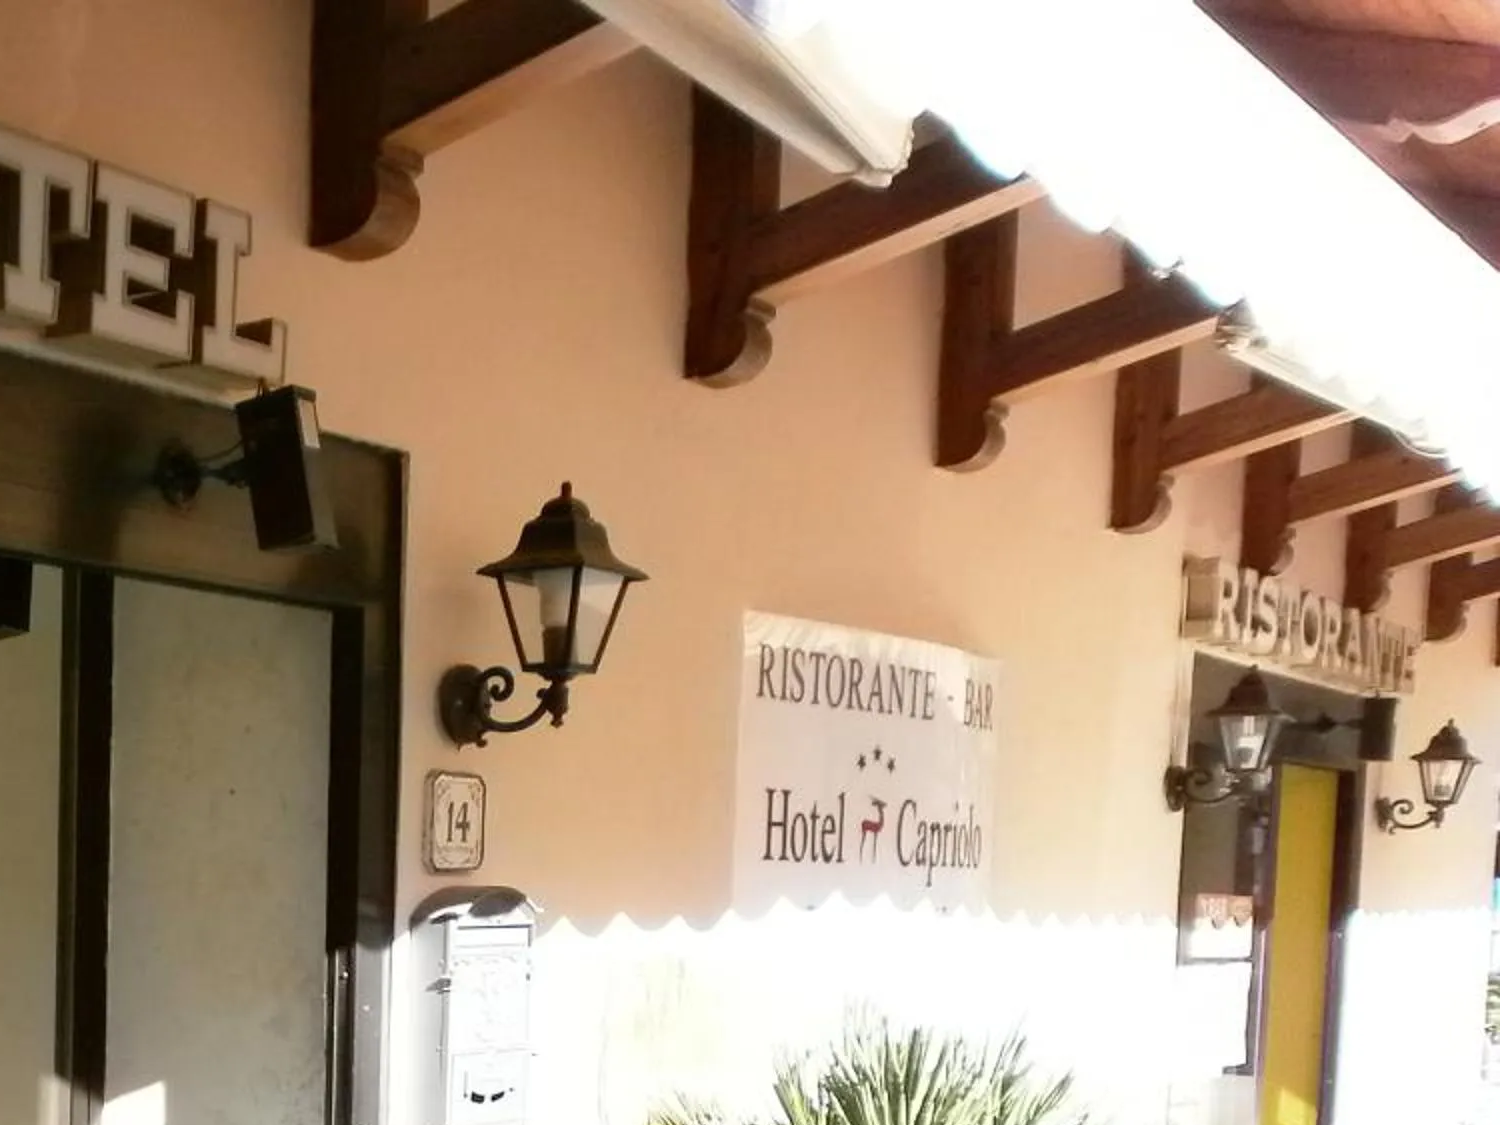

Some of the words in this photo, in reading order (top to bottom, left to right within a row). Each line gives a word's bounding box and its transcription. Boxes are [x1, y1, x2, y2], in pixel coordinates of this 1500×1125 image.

[1213, 562, 1415, 693] RISTORANTE
[756, 642, 936, 721] RISTORANTE
[962, 676, 994, 731] BAR
[446, 801, 471, 843] 14
[762, 787, 846, 864] Hotel
[895, 798, 983, 888] Capriolo
